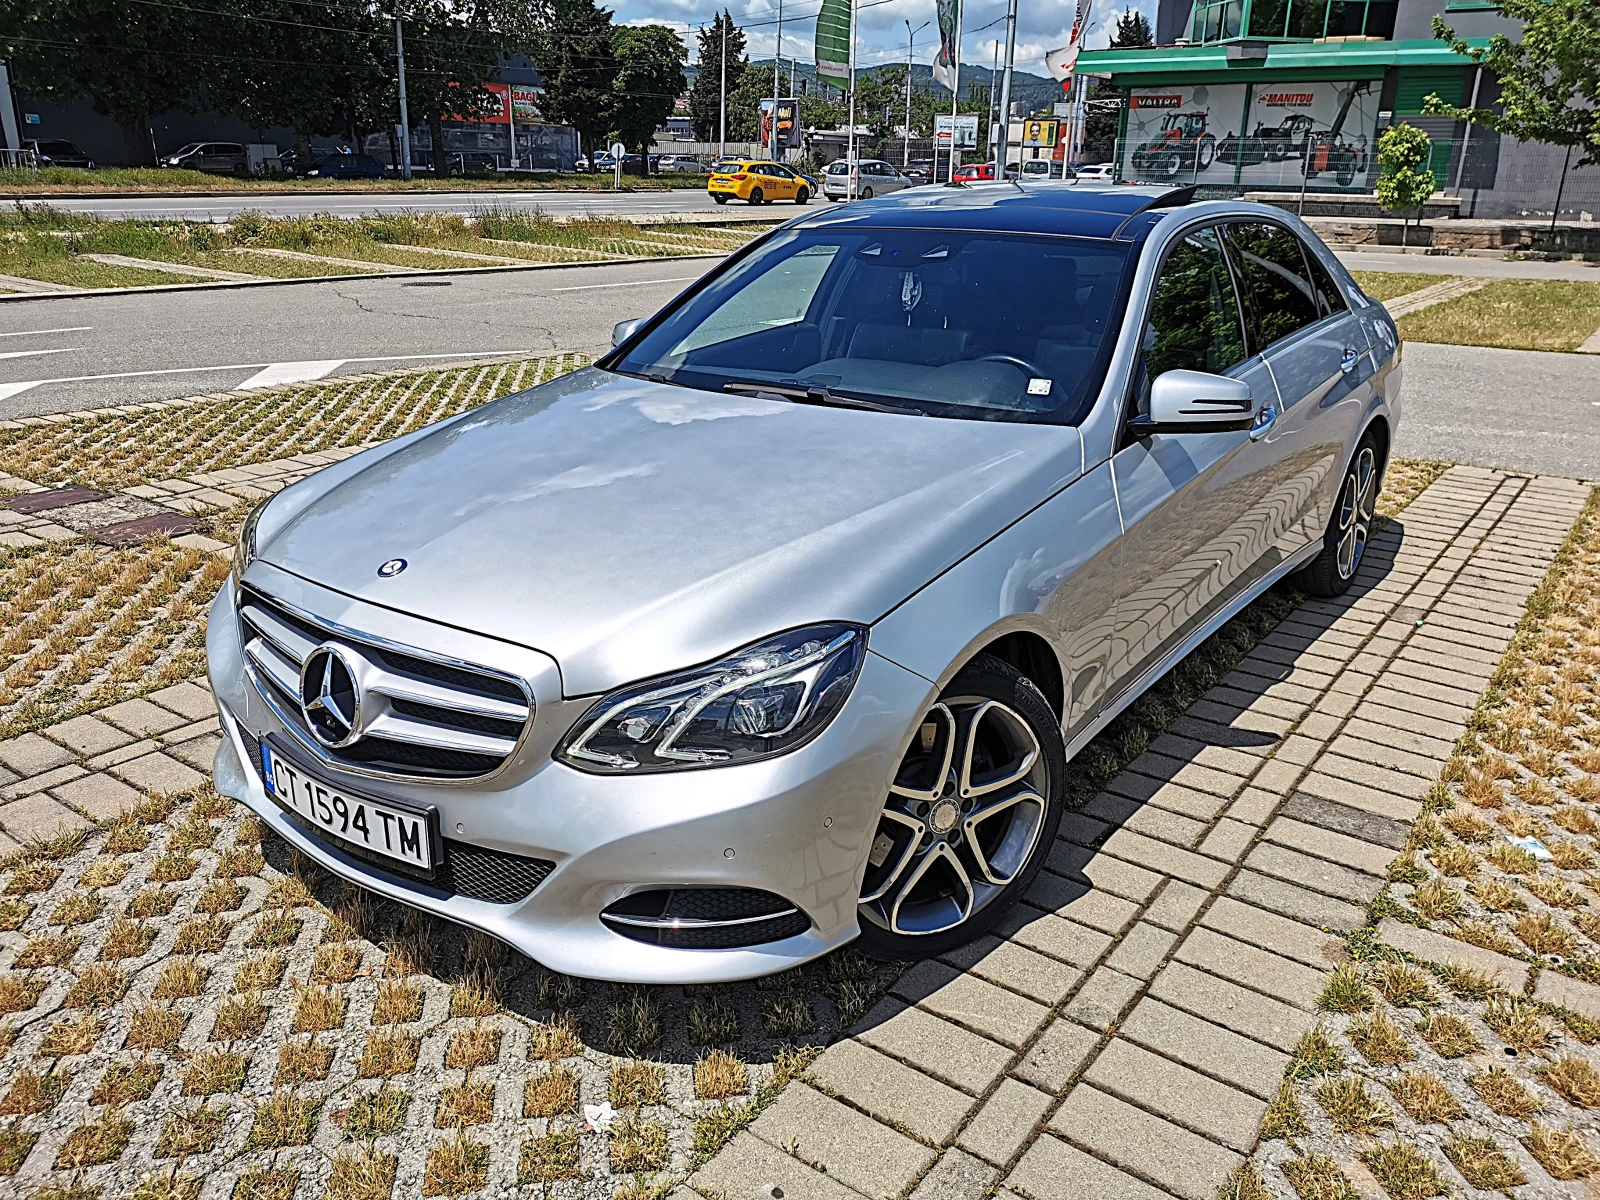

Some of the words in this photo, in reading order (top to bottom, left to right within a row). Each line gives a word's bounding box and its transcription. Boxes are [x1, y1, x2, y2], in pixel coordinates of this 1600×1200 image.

[1138, 98, 1178, 106] VALTRA
[1267, 93, 1314, 102] MANITOU
[273, 758, 298, 807] CT
[304, 781, 370, 843] 1594
[375, 809, 422, 861] TM
